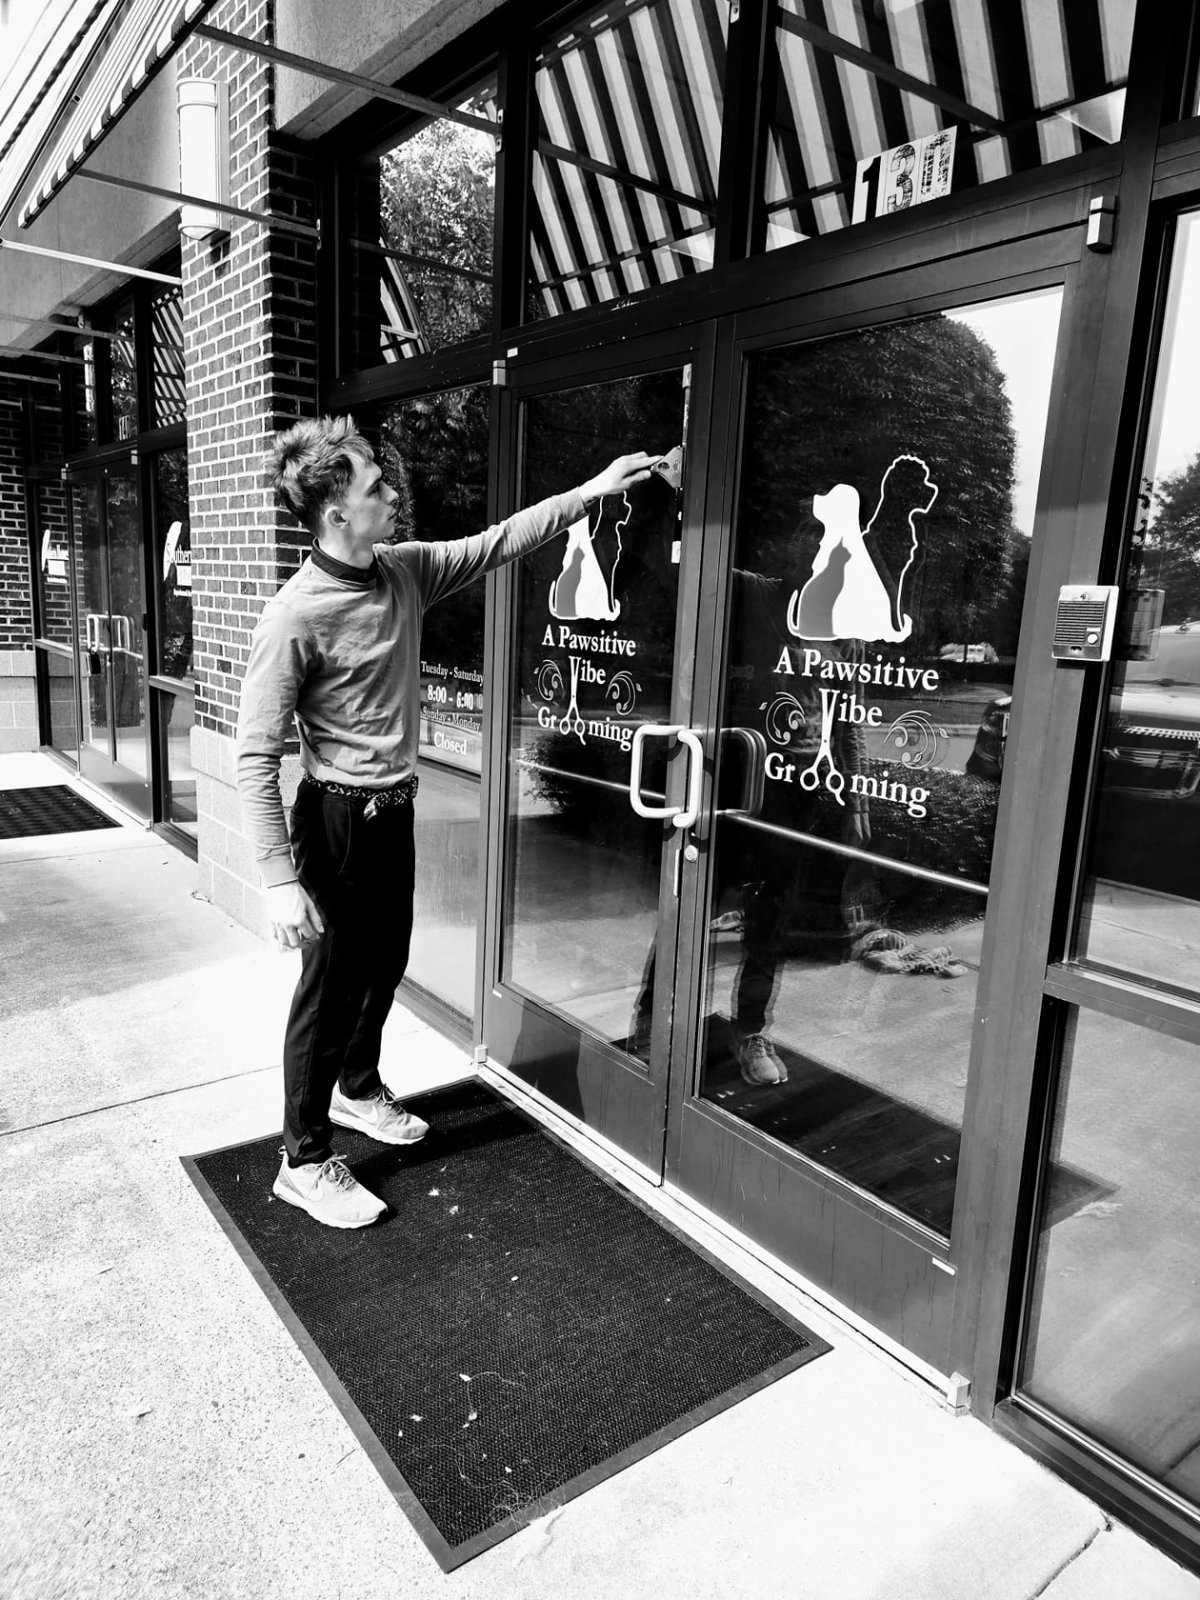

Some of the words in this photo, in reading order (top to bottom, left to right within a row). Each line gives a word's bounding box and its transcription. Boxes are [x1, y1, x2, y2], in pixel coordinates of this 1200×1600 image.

[861, 133, 952, 220] 130
[540, 624, 555, 647] A
[558, 625, 636, 656] Pawsitive
[421, 660, 448, 680] Tuesday
[453, 666, 484, 687] Saturday
[568, 655, 606, 685] Vibe
[773, 646, 795, 675] A
[801, 648, 939, 691] Pawsitive
[427, 684, 447, 704] 8:00
[818, 687, 883, 727] Vibe
[422, 705, 446, 726] Sunday
[451, 713, 481, 733] Monday
[537, 706, 633, 751] Grooming
[433, 731, 467, 756] Closed
[764, 752, 931, 818] Grooming
